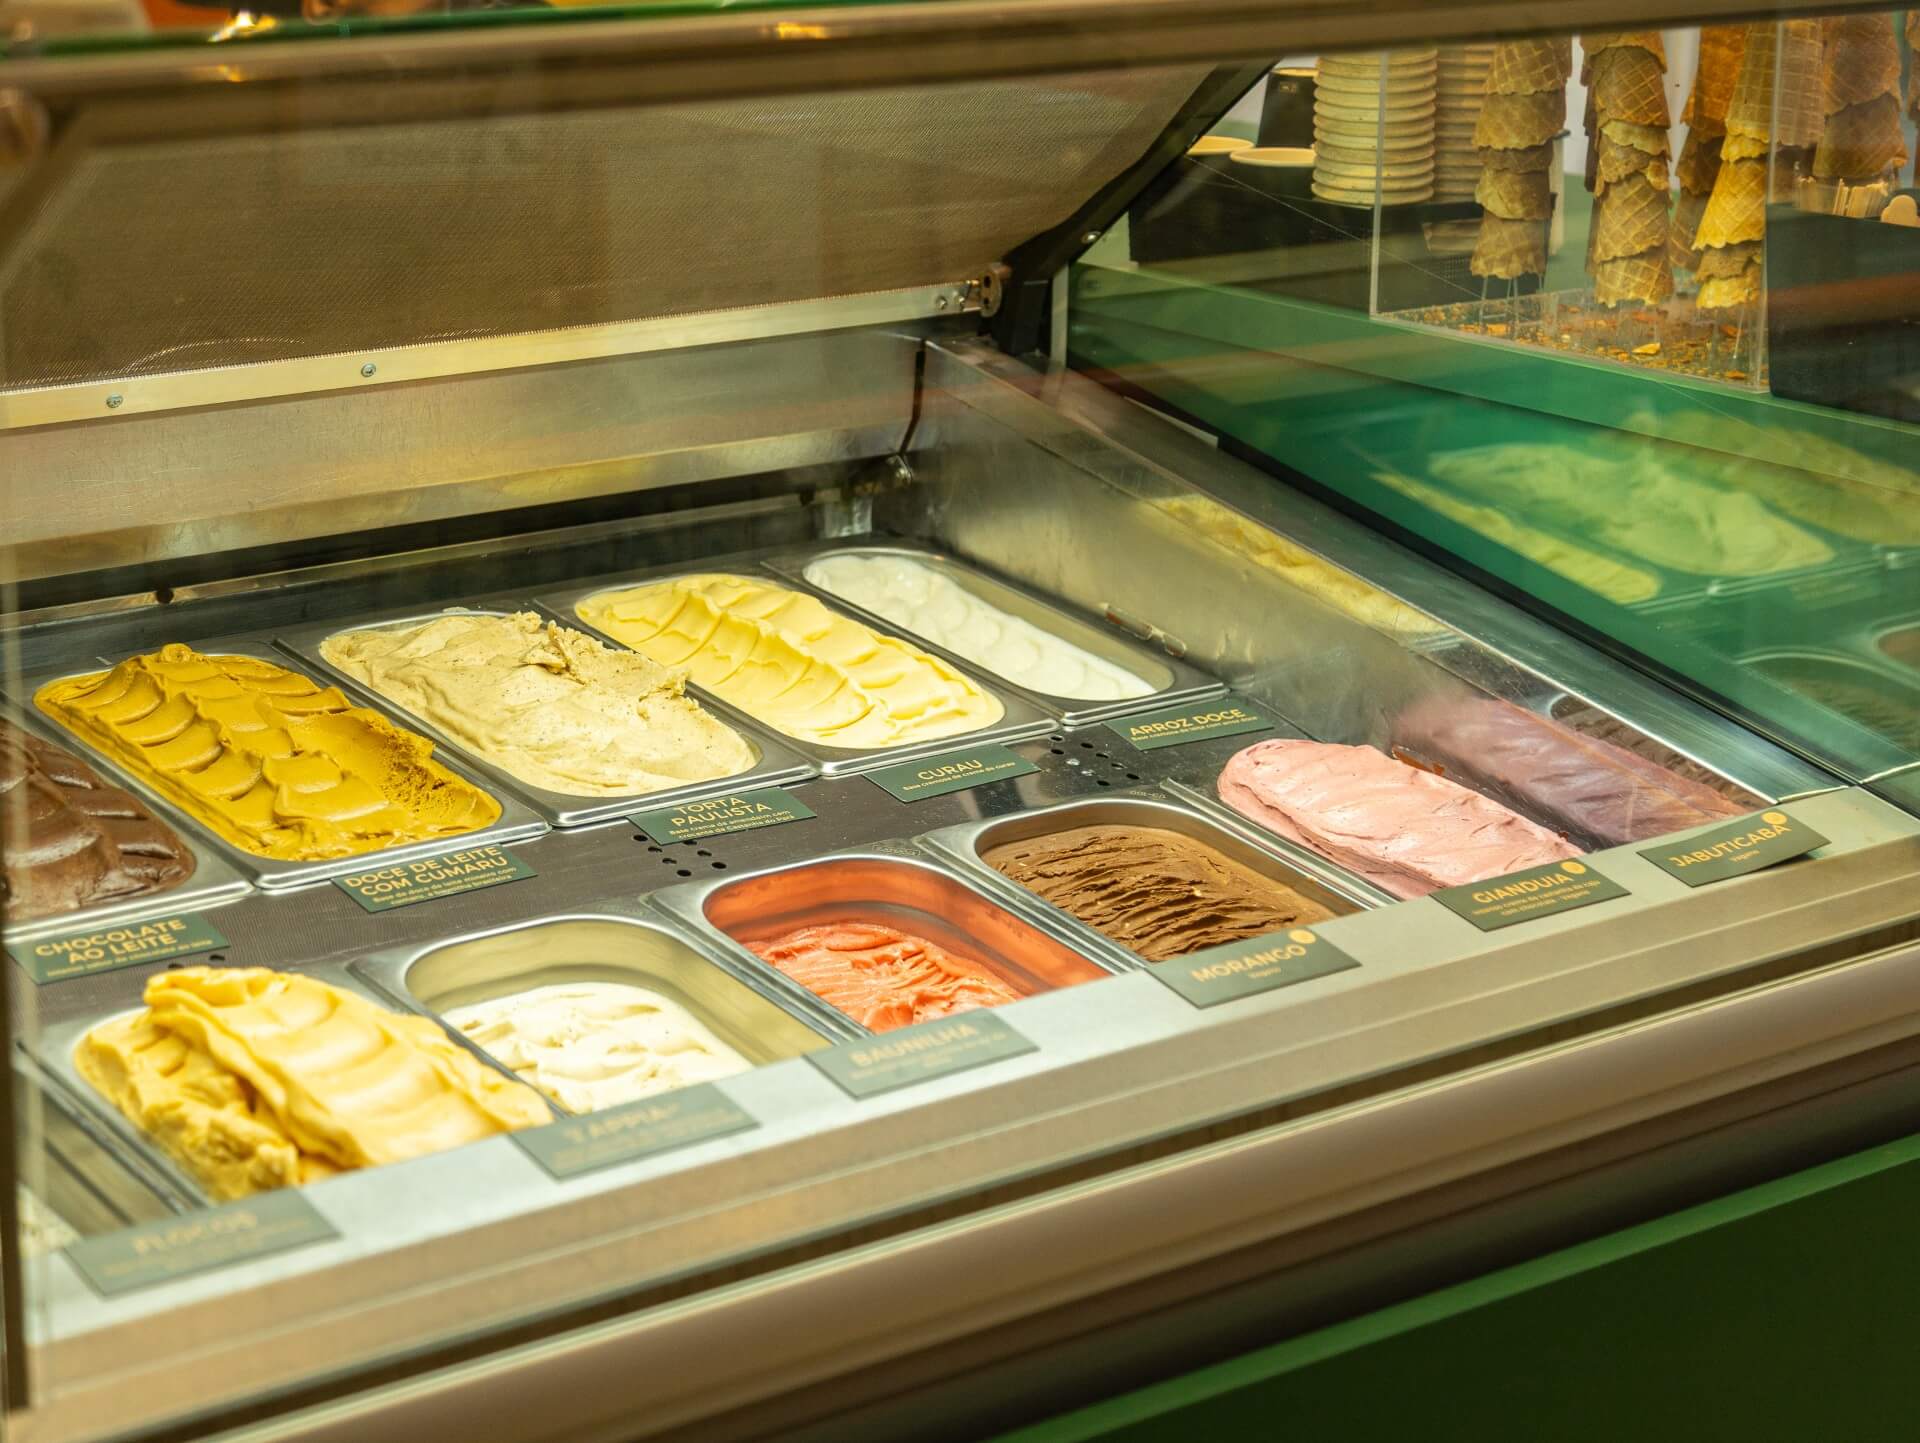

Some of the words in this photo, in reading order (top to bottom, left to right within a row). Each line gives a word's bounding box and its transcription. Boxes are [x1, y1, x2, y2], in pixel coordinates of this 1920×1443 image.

[1130, 719, 1194, 737] ARROZ
[1192, 709, 1248, 725] DOCE
[917, 759, 983, 780] CURAU
[671, 803, 771, 826] PAULISTA
[673, 797, 746, 815] TORTA
[1668, 824, 1792, 867] JABUTICABA
[345, 867, 408, 888] DOCE
[409, 858, 441, 873] DE
[443, 846, 502, 865] LEITE
[360, 879, 412, 896] COM
[415, 856, 508, 884] CUMARU
[35, 919, 186, 956] CHOCOLATE
[68, 949, 104, 964] AO
[109, 933, 178, 955] LEITE
[1190, 943, 1307, 983] MORANGO
